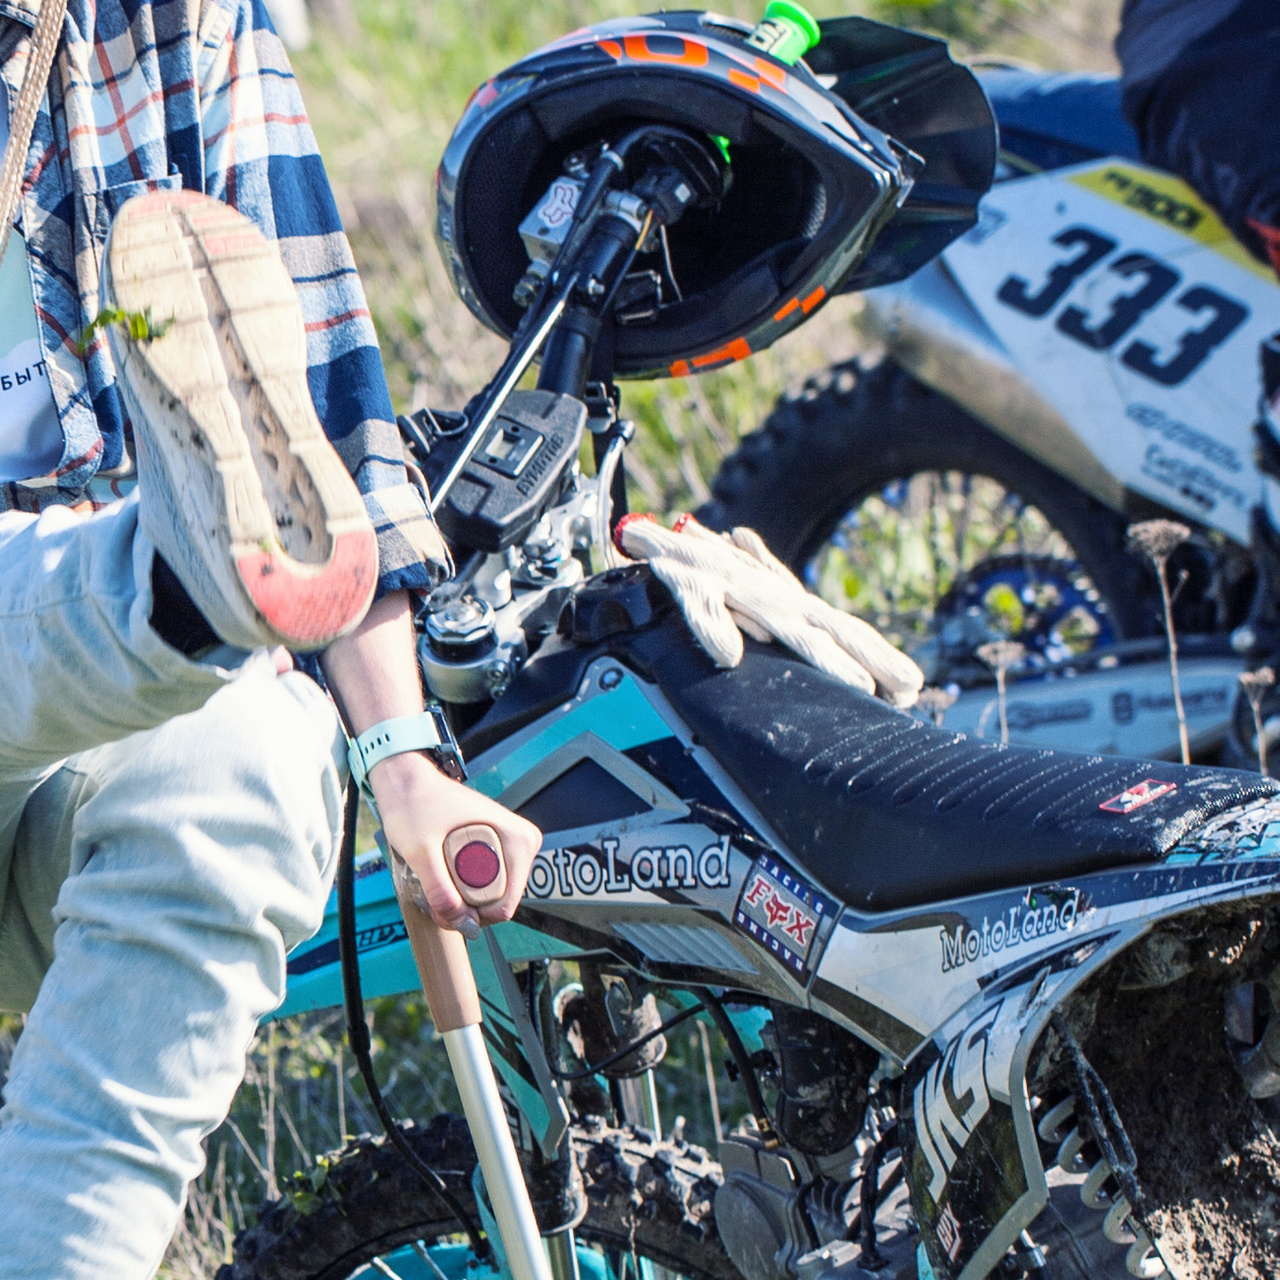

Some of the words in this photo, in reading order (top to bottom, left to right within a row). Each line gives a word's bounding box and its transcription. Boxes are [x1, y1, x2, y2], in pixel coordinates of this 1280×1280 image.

[996, 224, 1251, 387] 333
[522, 832, 734, 900] otoLand
[940, 887, 1081, 974] MotoLand
